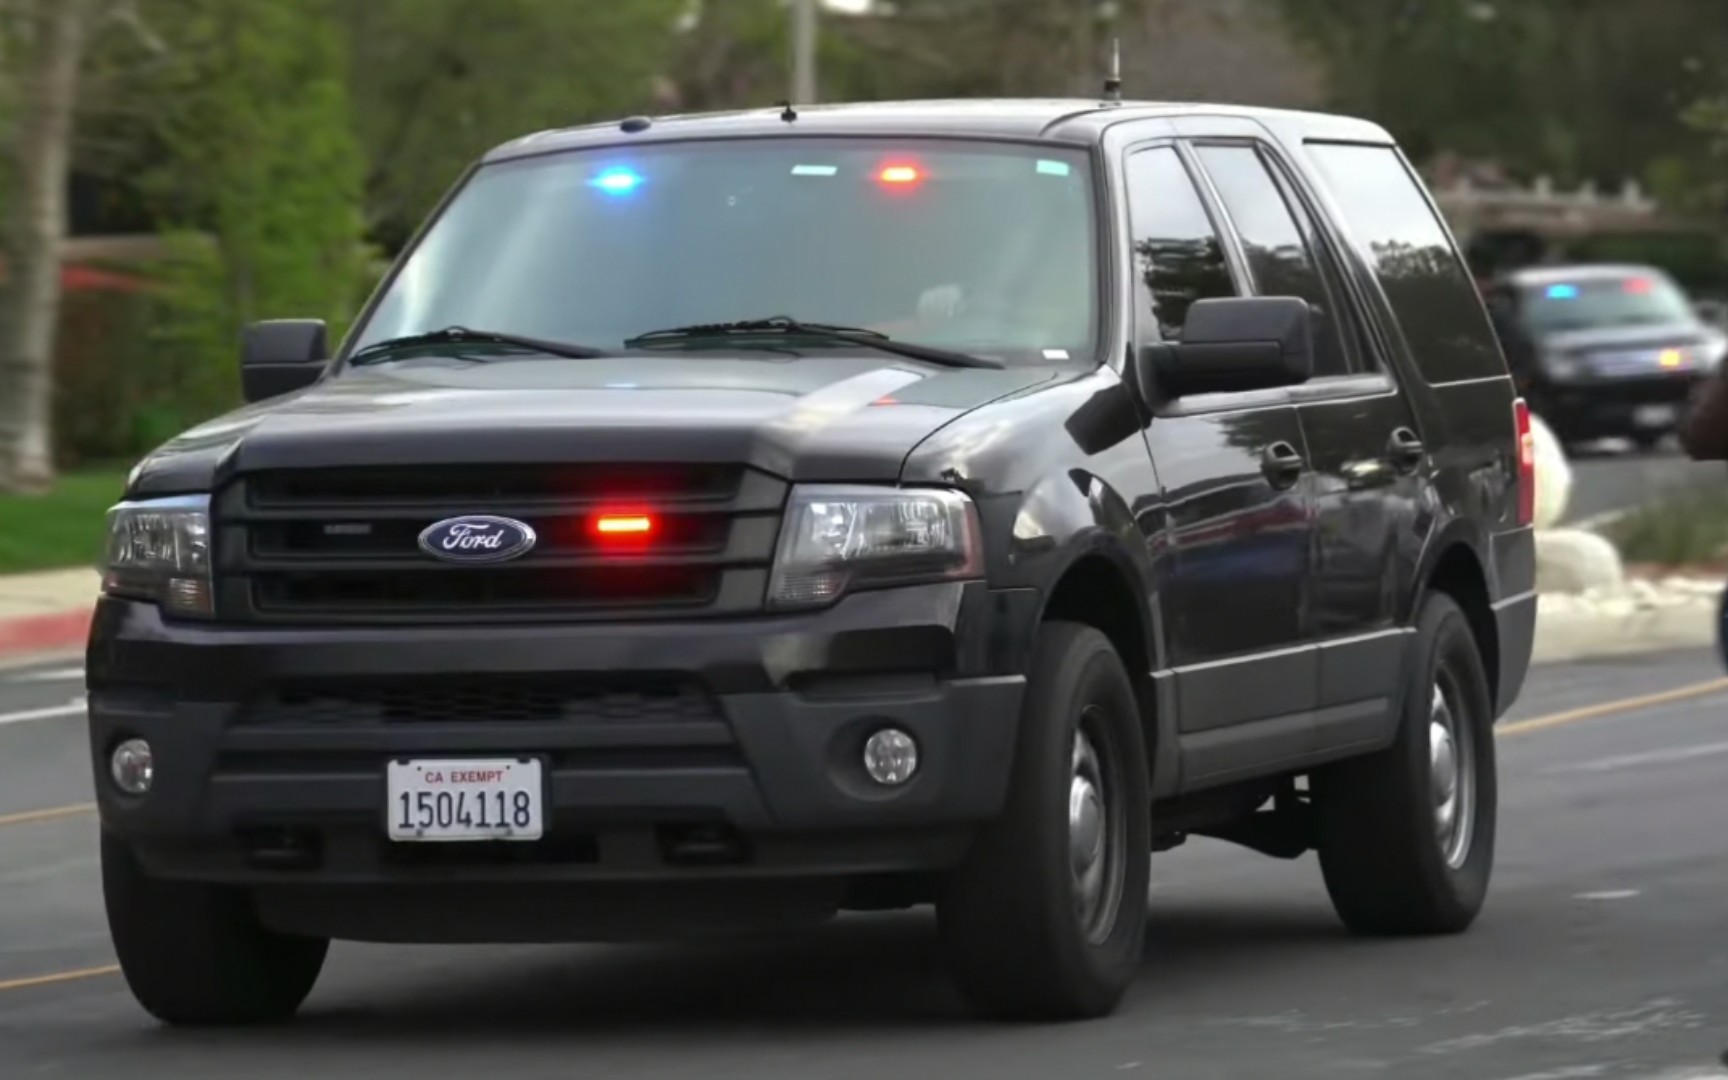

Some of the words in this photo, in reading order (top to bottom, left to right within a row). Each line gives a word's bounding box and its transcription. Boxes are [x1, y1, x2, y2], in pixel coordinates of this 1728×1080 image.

[442, 523, 504, 550] Ford
[425, 772, 443, 783] CA
[451, 771, 503, 783] EXEMPT
[399, 790, 530, 829] 1504118
